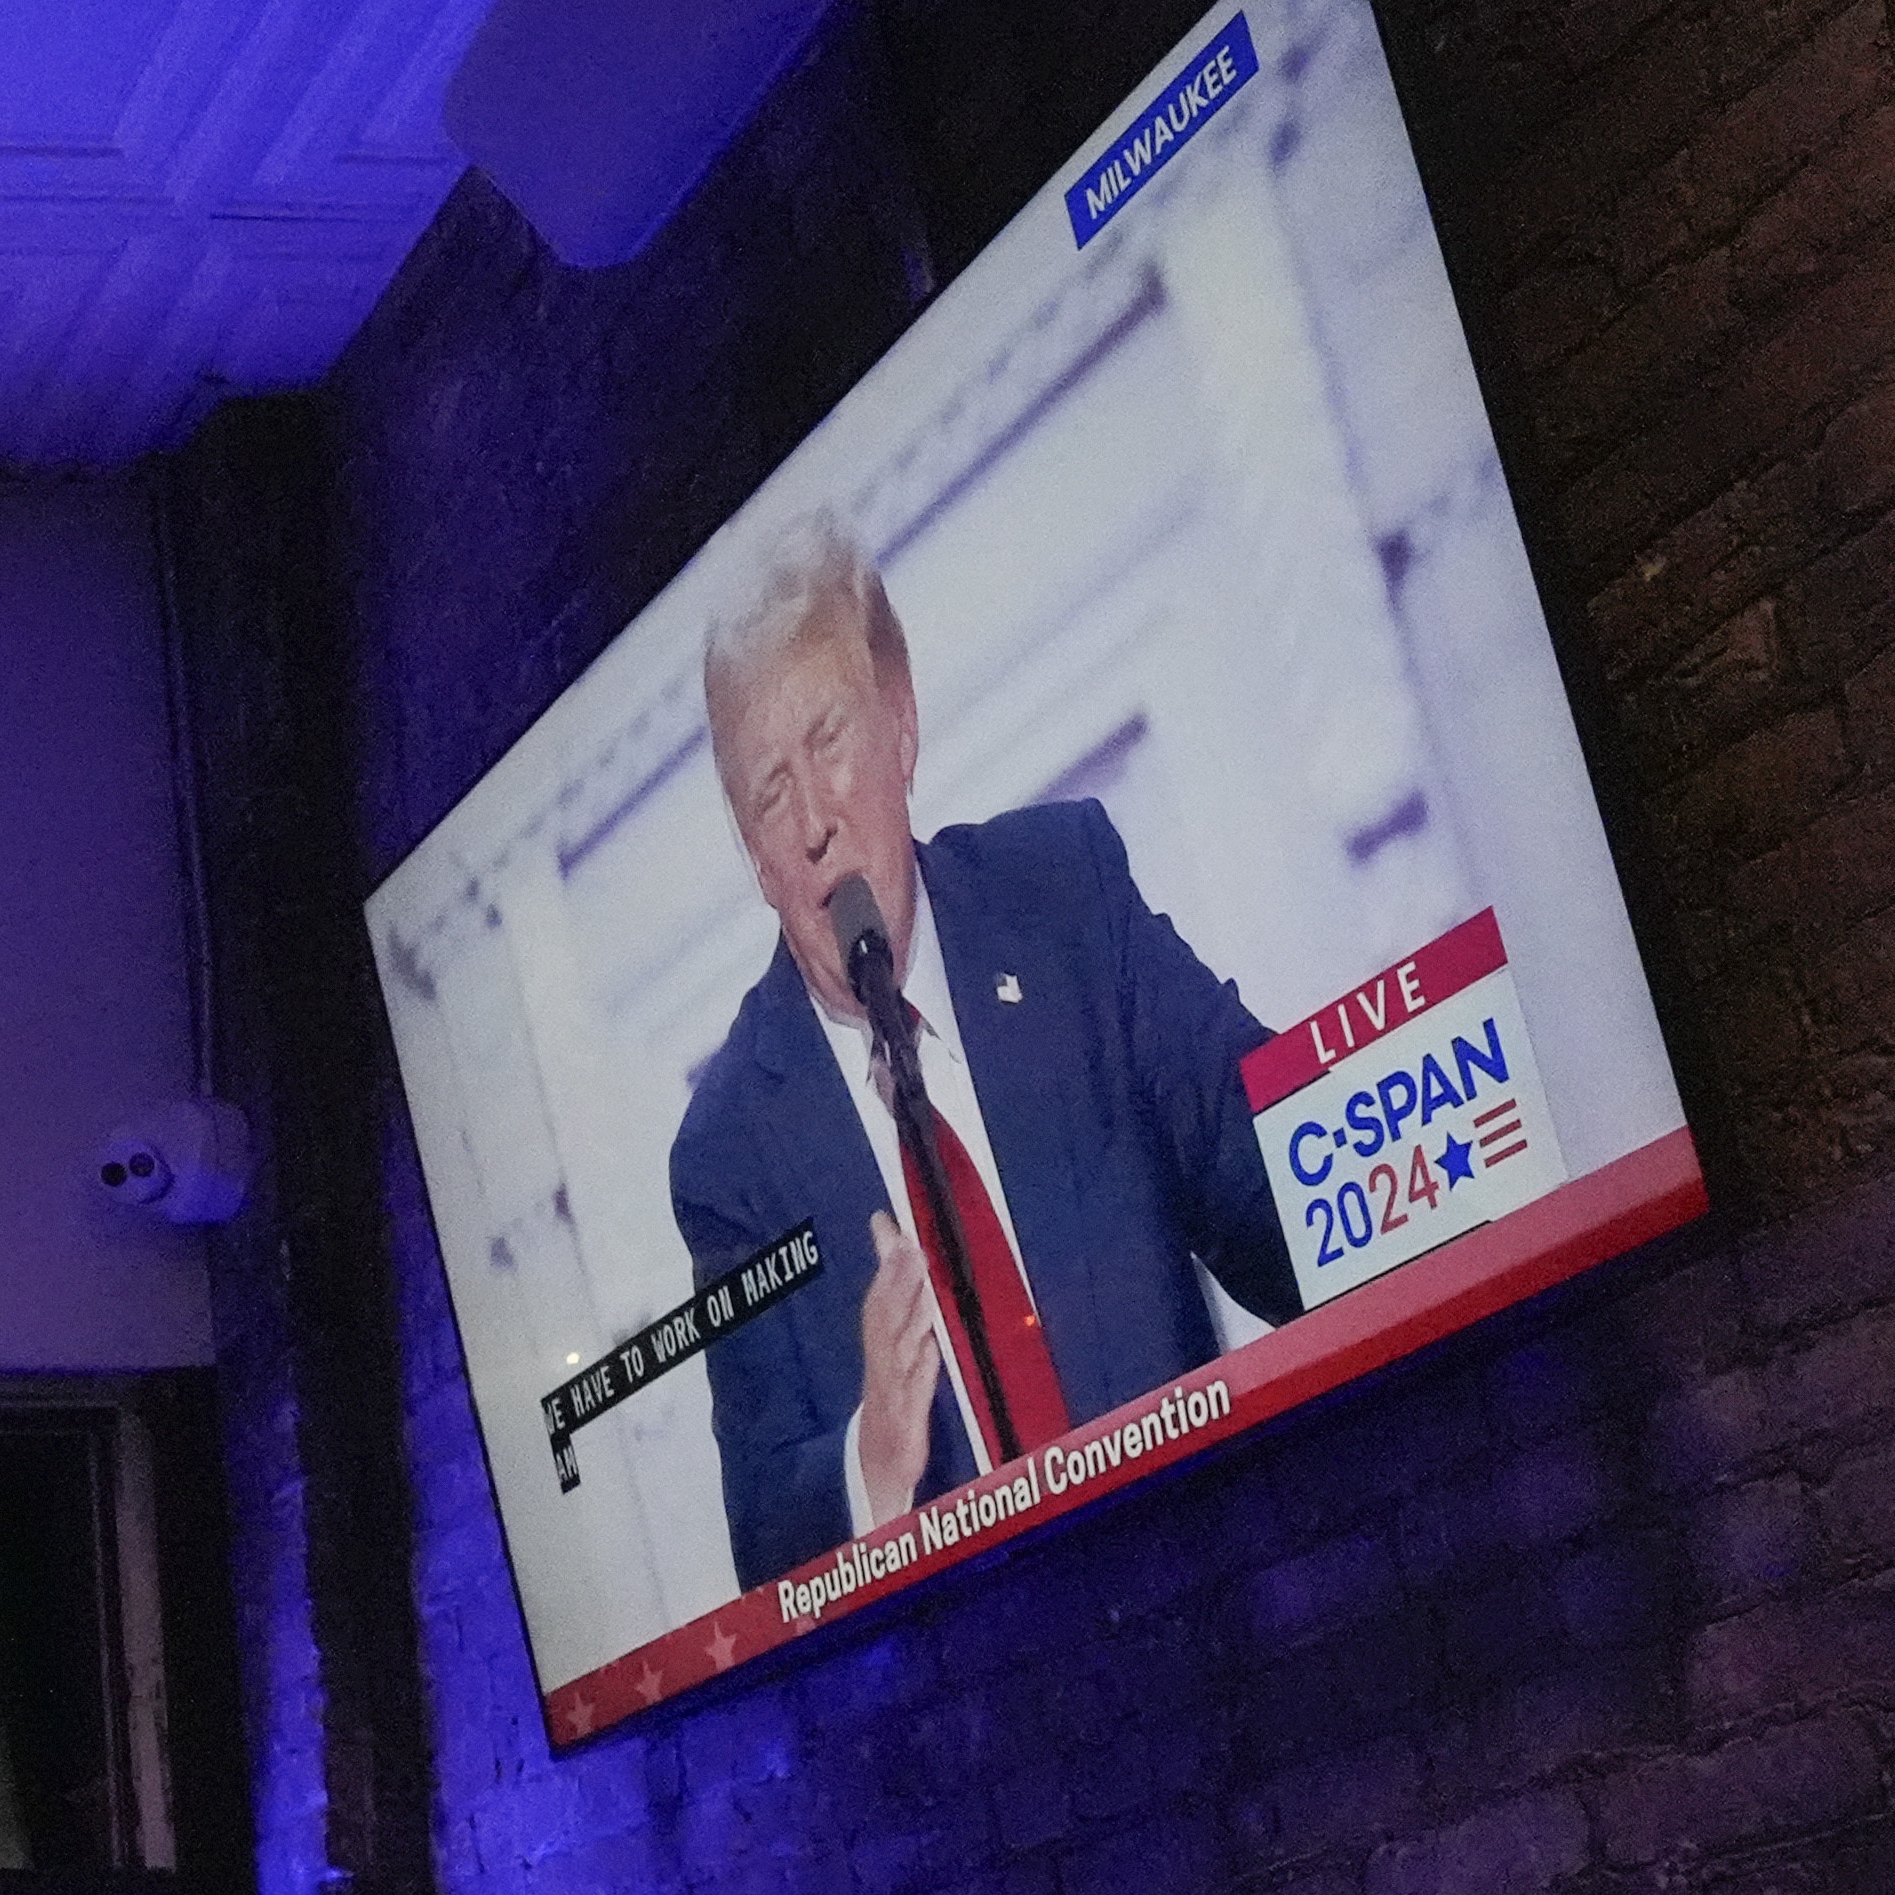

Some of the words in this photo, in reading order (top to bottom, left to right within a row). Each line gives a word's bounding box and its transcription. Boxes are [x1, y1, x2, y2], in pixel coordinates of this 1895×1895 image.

[1083, 45, 1238, 220] MILWAUKEE
[1309, 960, 1426, 1065] LIVE
[1305, 1144, 1440, 1267] 2024
[570, 1365, 615, 1418] HAVE
[620, 1345, 645, 1384] TO
[651, 1308, 702, 1364] WORK
[706, 1285, 735, 1329] ON
[740, 1231, 820, 1307] MAKING
[777, 1530, 919, 1624] Republican
[919, 1456, 1043, 1556] National
[1044, 1379, 1232, 1496] Convention
